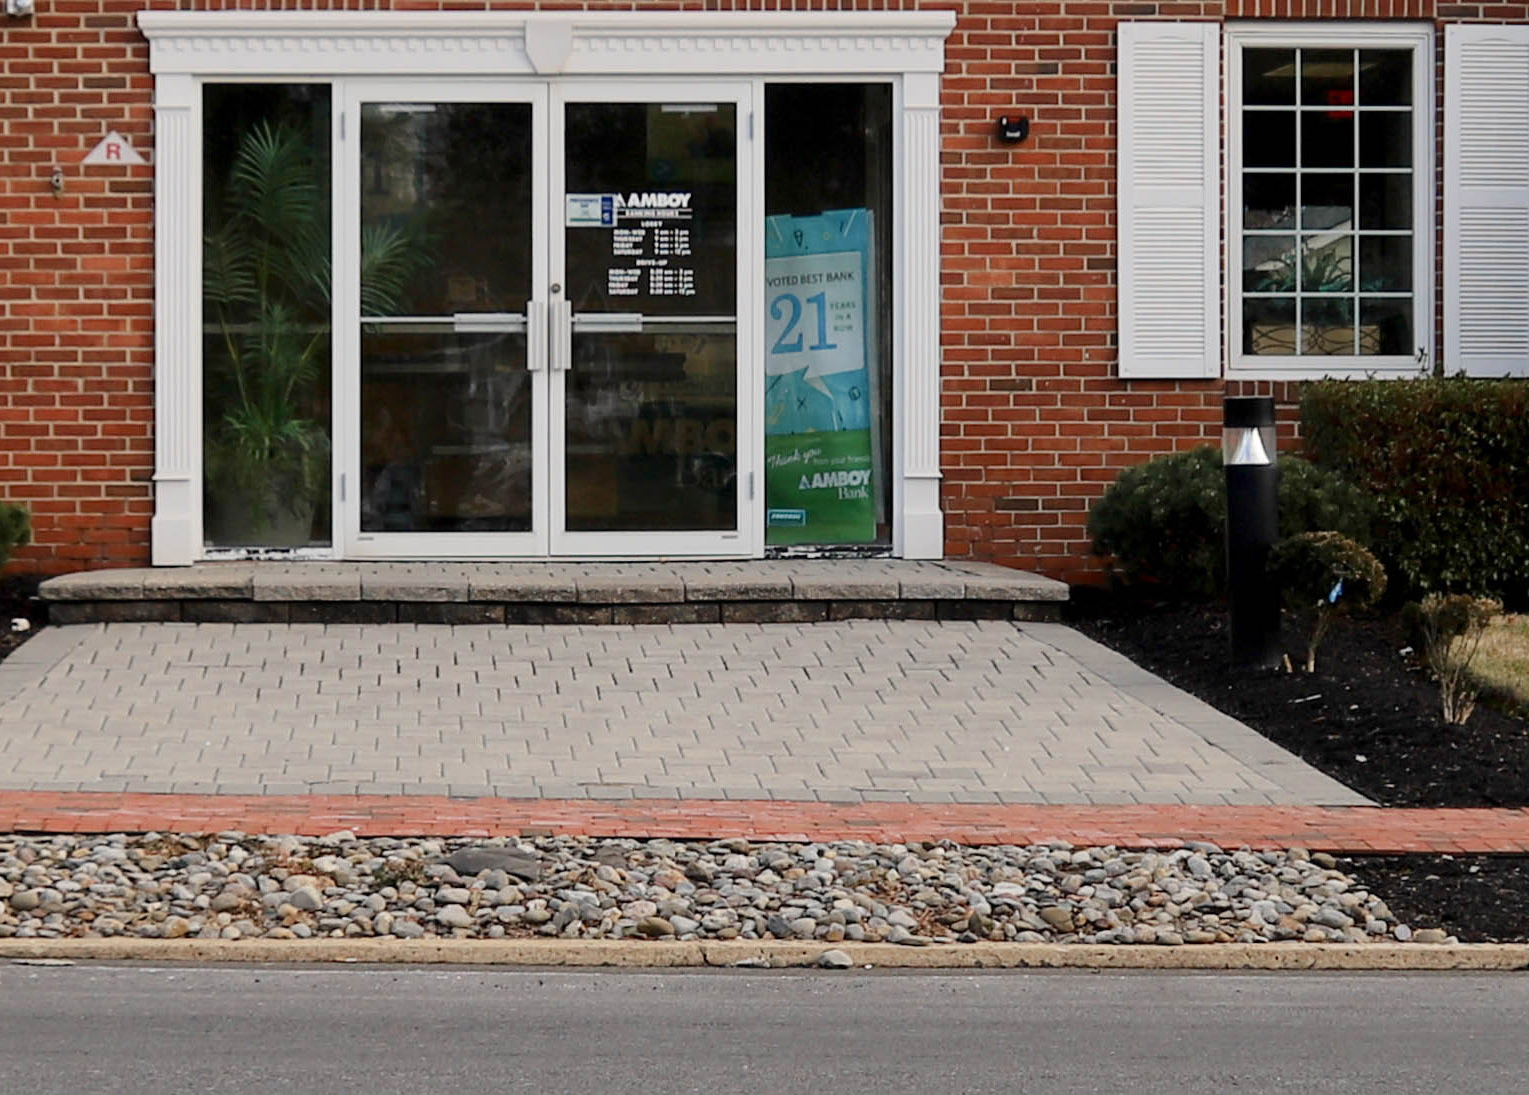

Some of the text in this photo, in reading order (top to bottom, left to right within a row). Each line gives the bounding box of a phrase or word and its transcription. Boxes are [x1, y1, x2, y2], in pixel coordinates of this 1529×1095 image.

[106, 143, 121, 160] R
[627, 192, 692, 208] AMBOY
[766, 271, 855, 287] VOTED BEST BANK
[830, 301, 856, 310] YEARS
[770, 291, 838, 354] 21
[767, 448, 821, 468] Thank you
[811, 470, 872, 489] AMBOY
[838, 485, 868, 500] Bank
